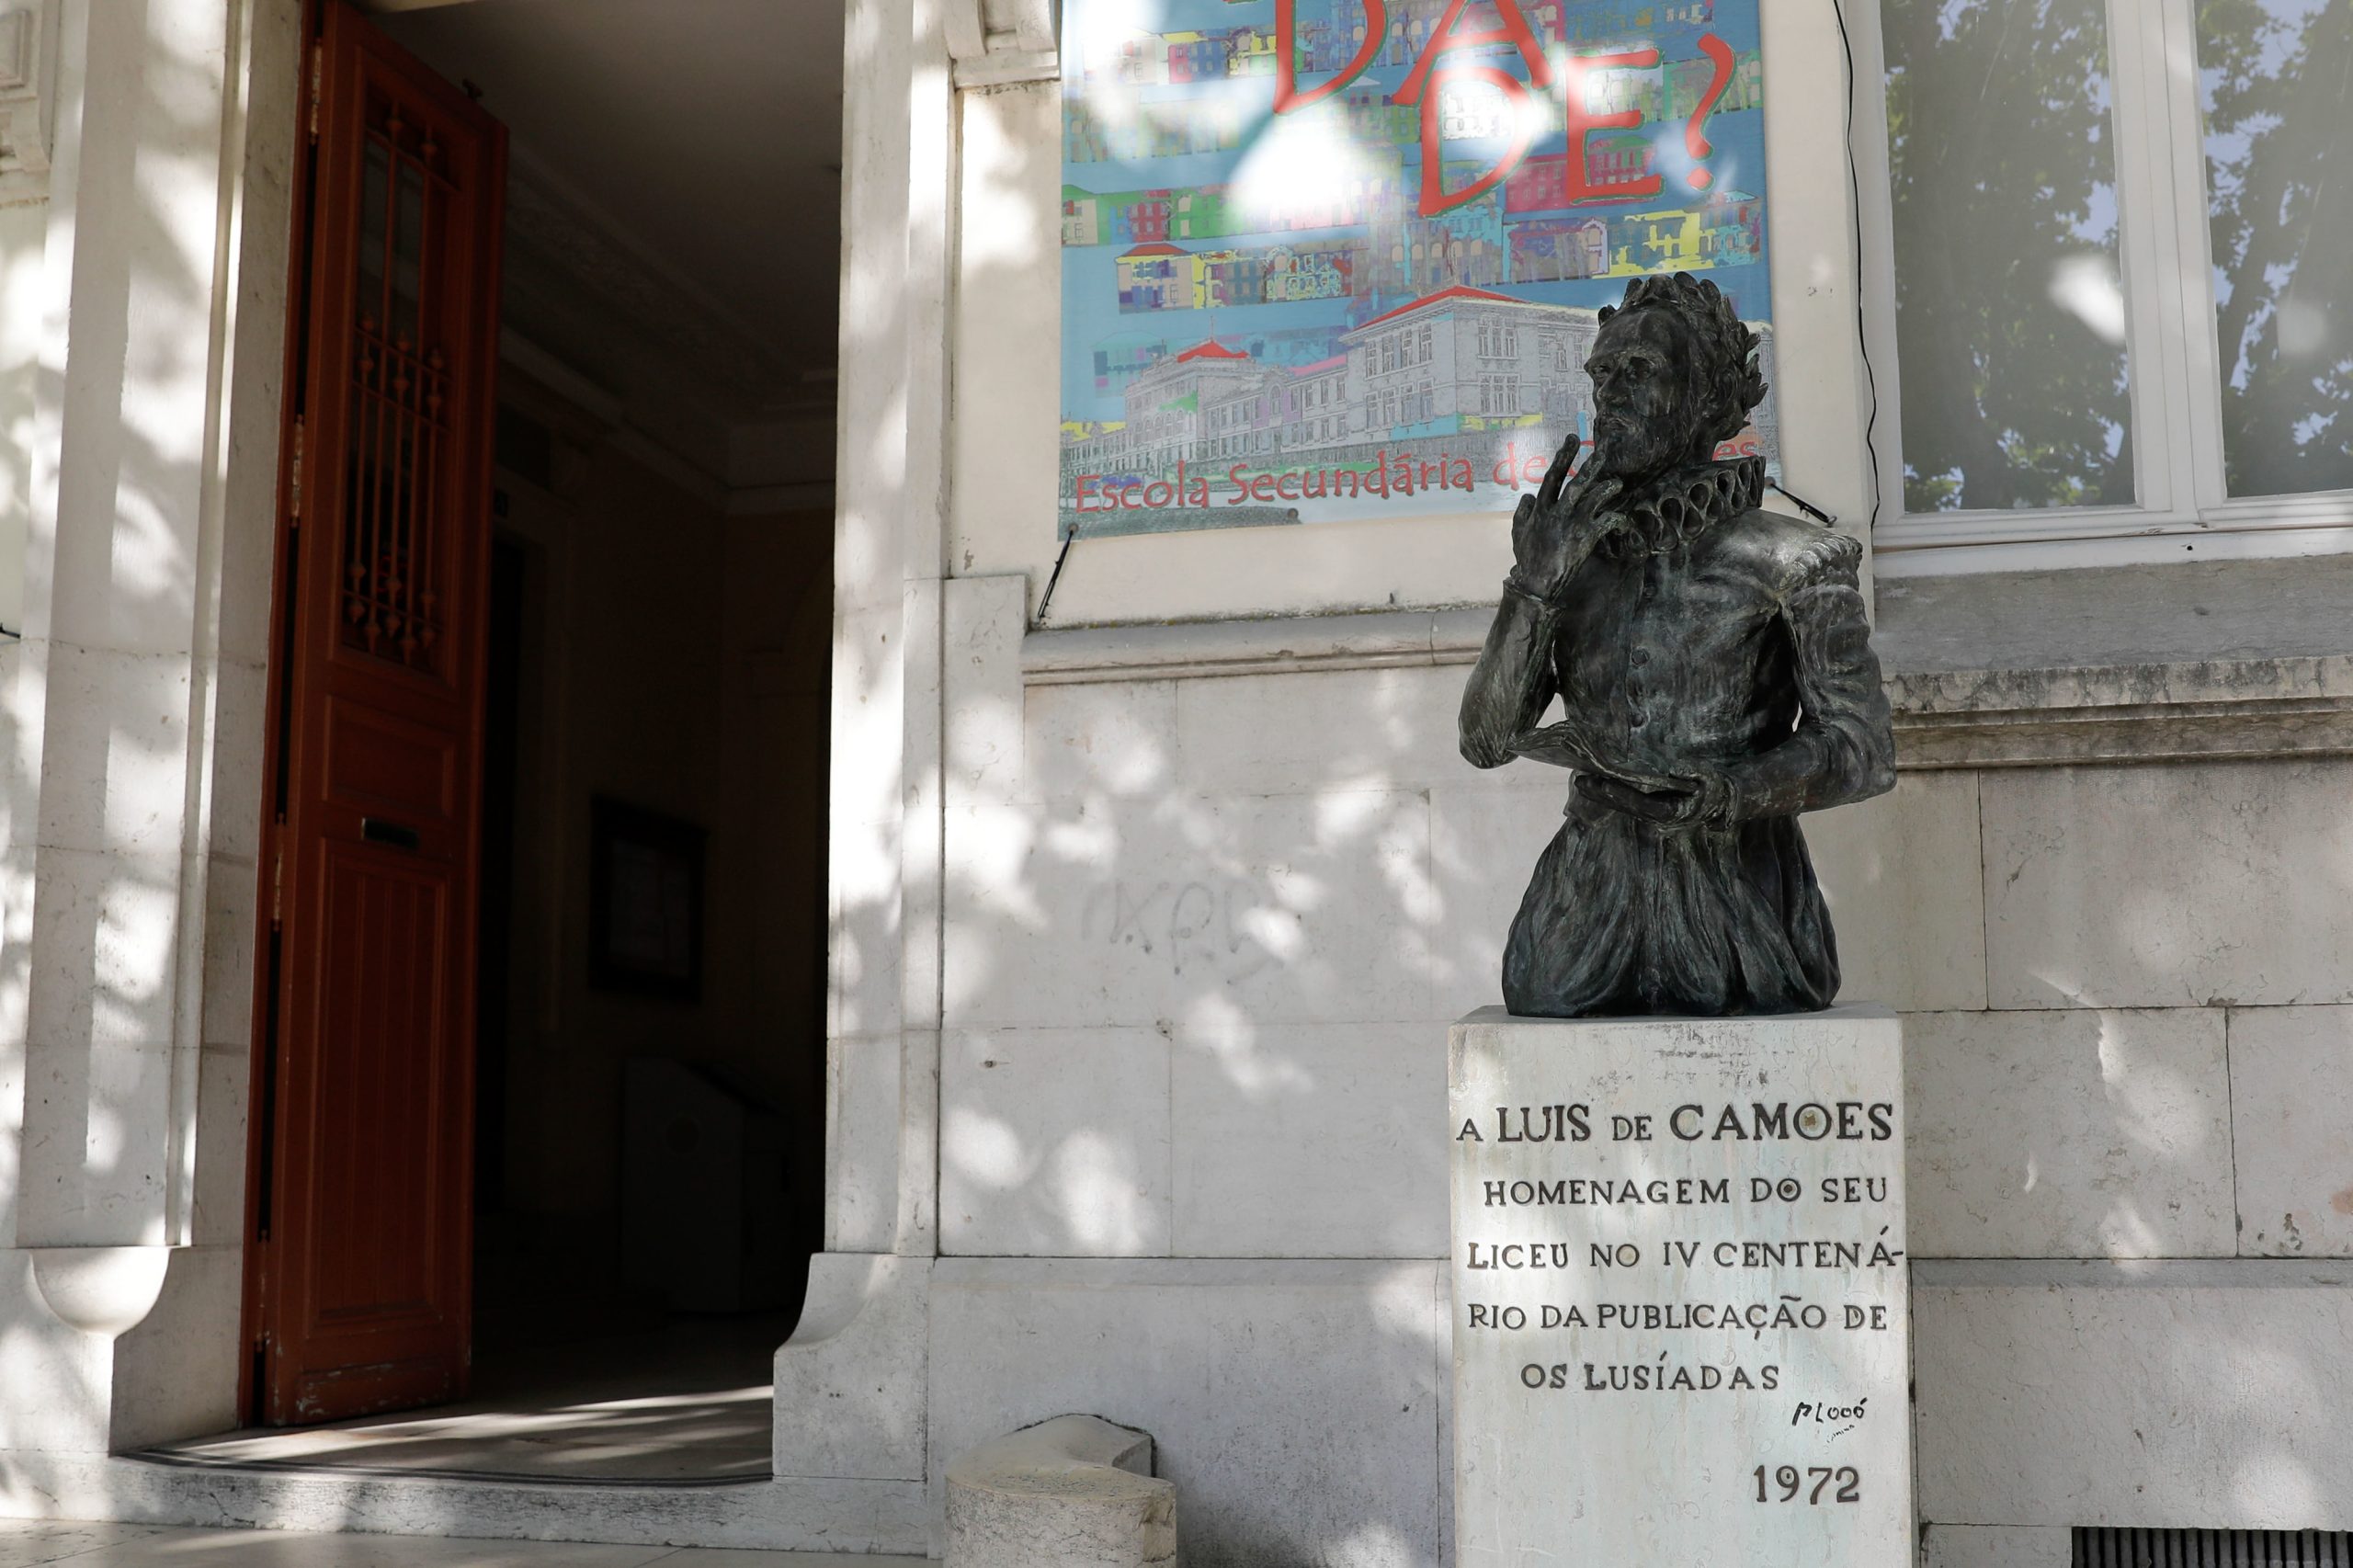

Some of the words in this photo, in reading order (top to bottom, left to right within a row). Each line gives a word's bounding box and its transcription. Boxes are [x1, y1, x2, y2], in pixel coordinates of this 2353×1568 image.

[1075, 459, 1210, 514] Escola
[1228, 450, 1474, 506] Secundária
[1493, 441, 1547, 491] de
[1456, 1119, 1484, 1142] A
[1497, 1104, 1591, 1142] LUIS
[1612, 1116, 1653, 1142] DE
[1669, 1102, 1893, 1142] CAMOES
[1483, 1177, 1730, 1207] HOMENAGEM
[1751, 1177, 1802, 1203] DO
[1823, 1176, 1888, 1204] SEU
[1468, 1242, 1568, 1270] LICEU
[1590, 1243, 1641, 1268] NO
[1664, 1242, 1700, 1267] IV
[1713, 1225, 1905, 1268] CENTENÁ-
[1468, 1303, 1527, 1331] RIO
[1540, 1304, 1588, 1329] DA
[1597, 1295, 1827, 1340] PUBLICAÇÃO
[1844, 1304, 1888, 1331] DE
[1520, 1364, 1568, 1390] OS
[1584, 1351, 1779, 1391] LUSÍADAS
[1753, 1464, 1860, 1506] 1972
